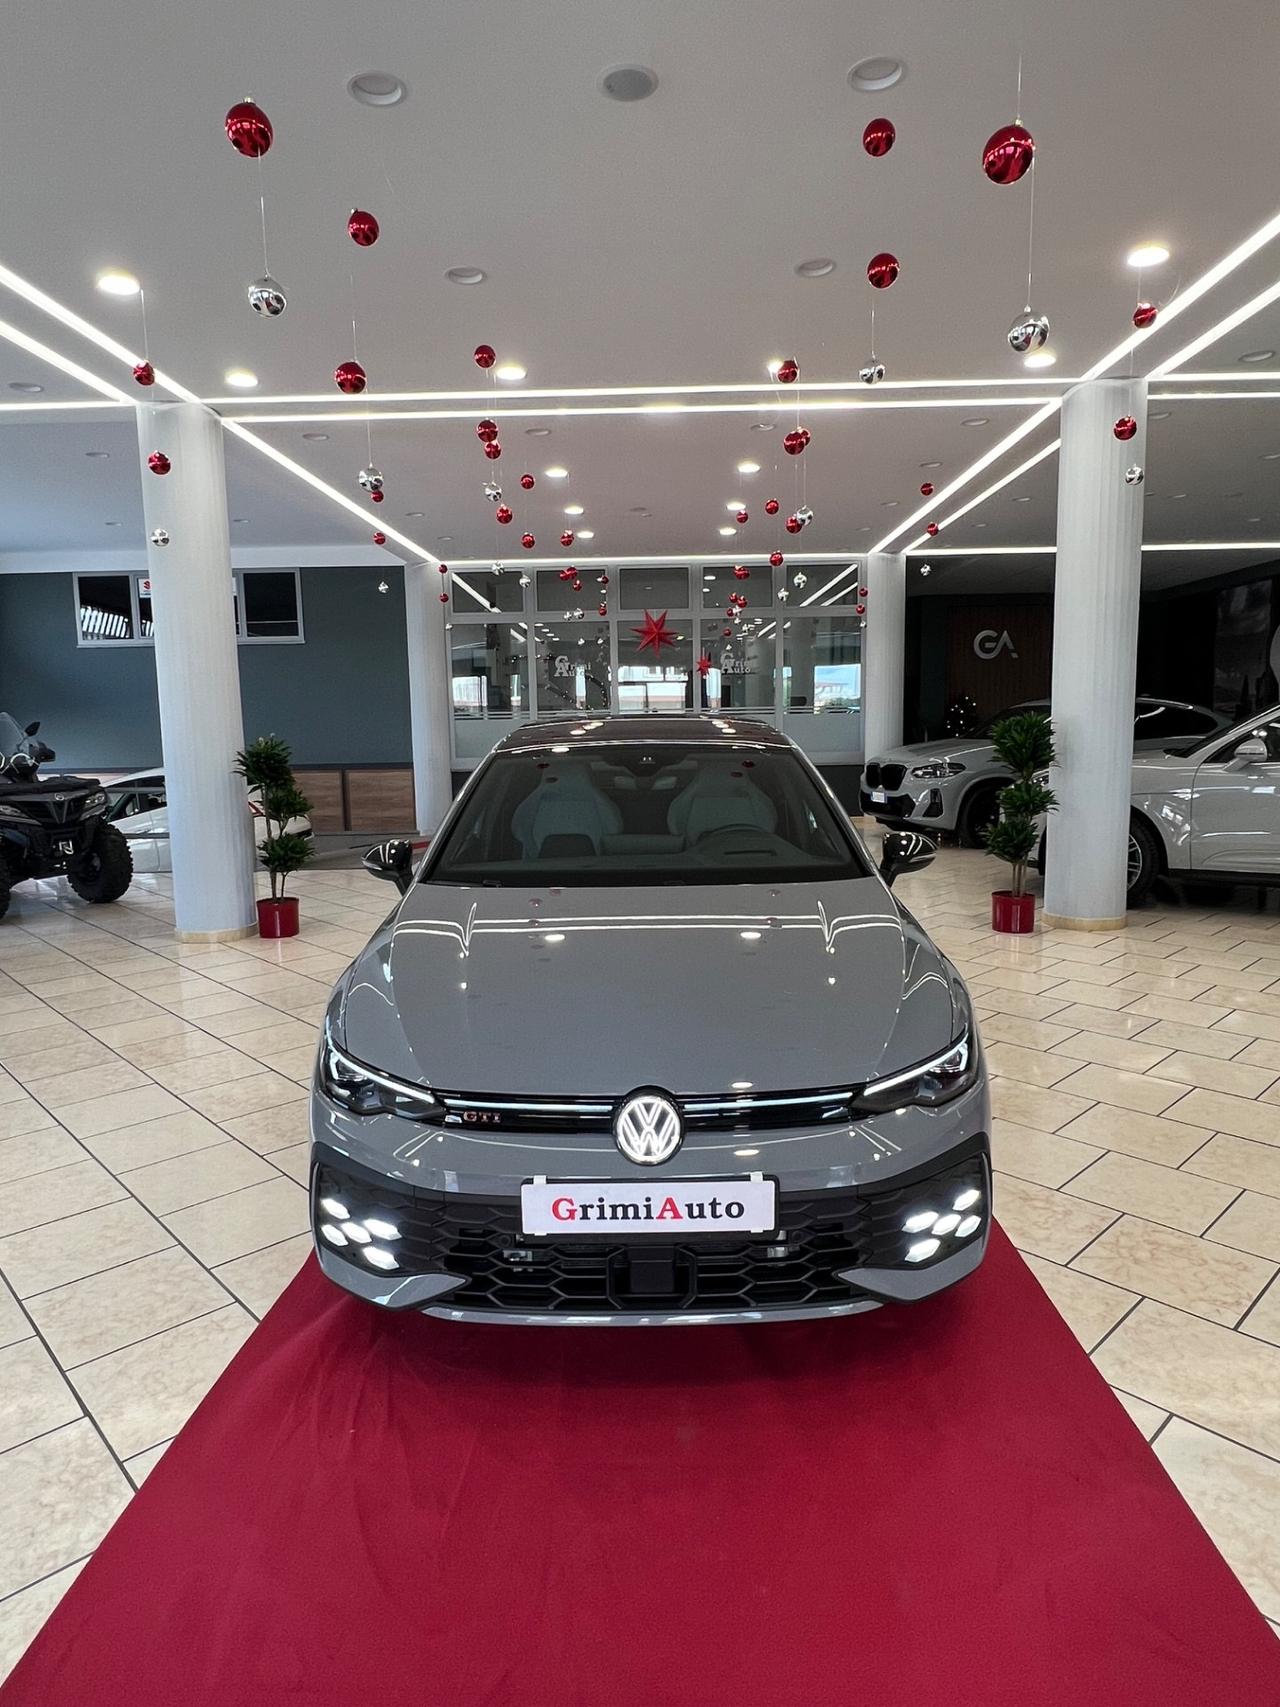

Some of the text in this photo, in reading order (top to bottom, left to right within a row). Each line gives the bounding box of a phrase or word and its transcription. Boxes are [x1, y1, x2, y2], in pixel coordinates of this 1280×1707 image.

[974, 629, 1019, 660] GA
[463, 1111, 502, 1123] GTI
[551, 1196, 746, 1221] GrimiAuto
